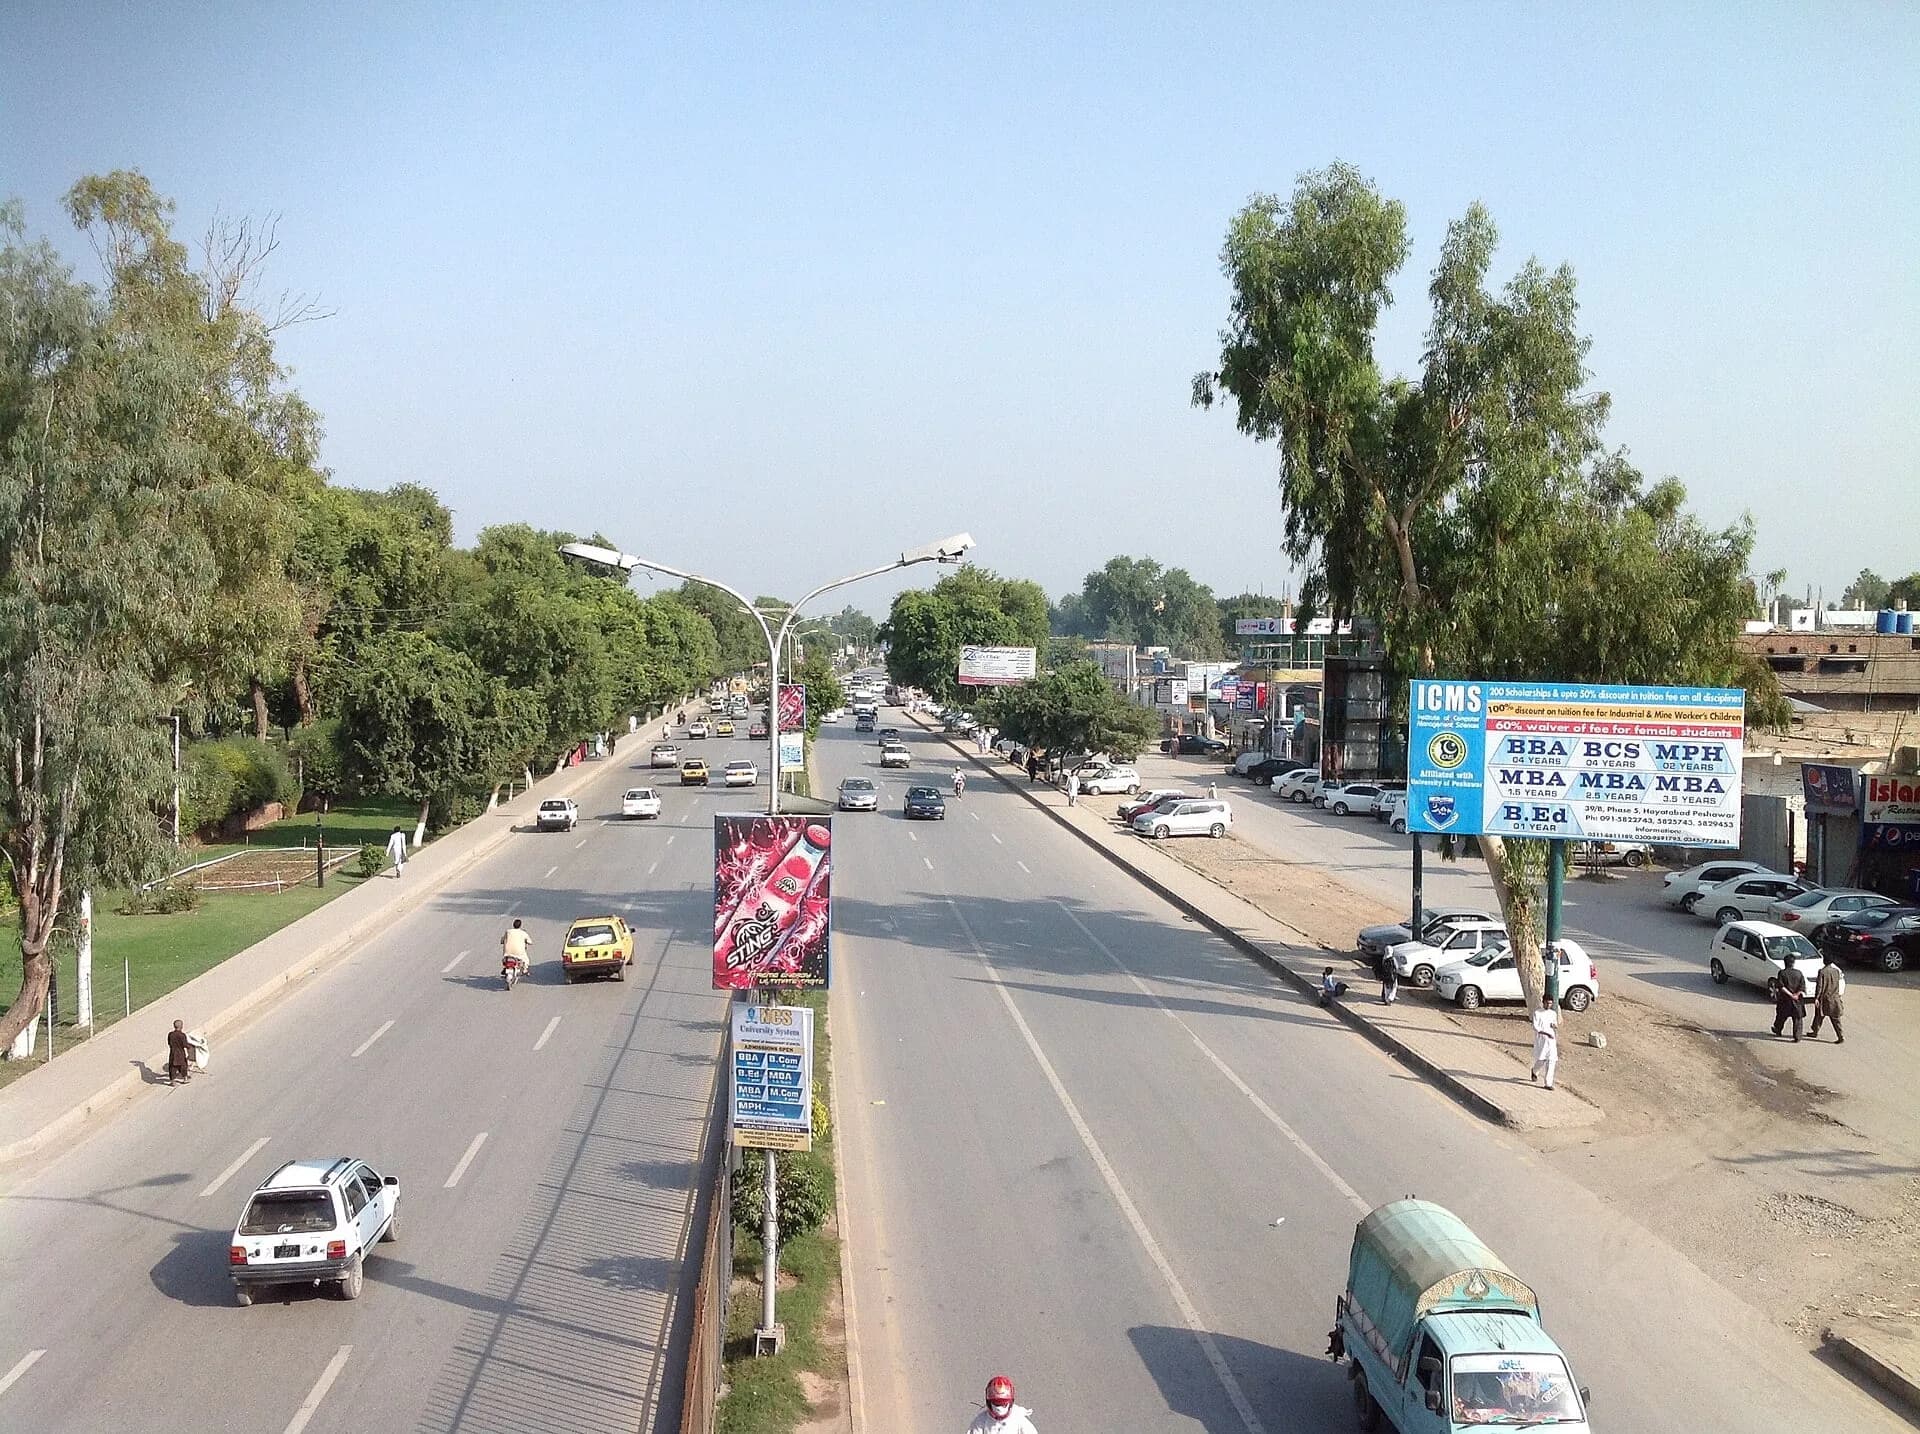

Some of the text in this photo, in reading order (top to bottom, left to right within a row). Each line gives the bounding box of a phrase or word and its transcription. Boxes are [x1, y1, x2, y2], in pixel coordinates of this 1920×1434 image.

[1418, 684, 1481, 712] ICMS
[1490, 688, 1504, 696] 200
[1506, 688, 1550, 699] Scholarships
[1552, 689, 1558, 697] &
[1560, 690, 1578, 700] upto
[1580, 690, 1596, 698] 50%
[1598, 690, 1630, 700] discount
[1640, 692, 1664, 700] tuition
[1666, 693, 1678, 701] fee
[1692, 693, 1701, 702] all
[1703, 694, 1742, 704] disciplines
[1488, 704, 1513, 714] 100%
[1515, 706, 1544, 714] discount
[1558, 708, 1580, 716] tuition
[1583, 708, 1594, 716] fee
[1597, 708, 1608, 716] for
[1610, 709, 1644, 718] Industrial
[1655, 711, 1672, 719] Mine
[1674, 712, 1708, 720] Worker's
[1710, 712, 1742, 720] Children
[1496, 721, 1732, 738] 60% waiver of fee for female students
[1507, 739, 1568, 756] BBA
[1584, 742, 1640, 758] BCS
[1656, 744, 1724, 762] MPH
[1602, 760, 1636, 768] YEARS
[1420, 770, 1474, 780] Affiliated with
[1500, 770, 1566, 786] MBA
[1580, 772, 1646, 790] MBA
[1656, 776, 1725, 794] MBA
[1524, 789, 1558, 797] YEARS
[1604, 792, 1638, 800] YEARS
[1682, 796, 1716, 804] YEARS
[1504, 806, 1568, 823] B.Ed
[1644, 808, 1690, 816] Hayatabad
[1692, 810, 1735, 818] Peshawar
[726, 926, 773, 970] STING
[740, 1025, 800, 1036] University System
[738, 1054, 758, 1062] BBA
[769, 1055, 798, 1064] B.Com
[738, 1069, 760, 1078] B.Ed
[769, 1072, 792, 1080] MBA
[738, 1086, 760, 1094] MBA
[770, 1088, 798, 1098] M.Com
[738, 1102, 762, 1110] MPH
